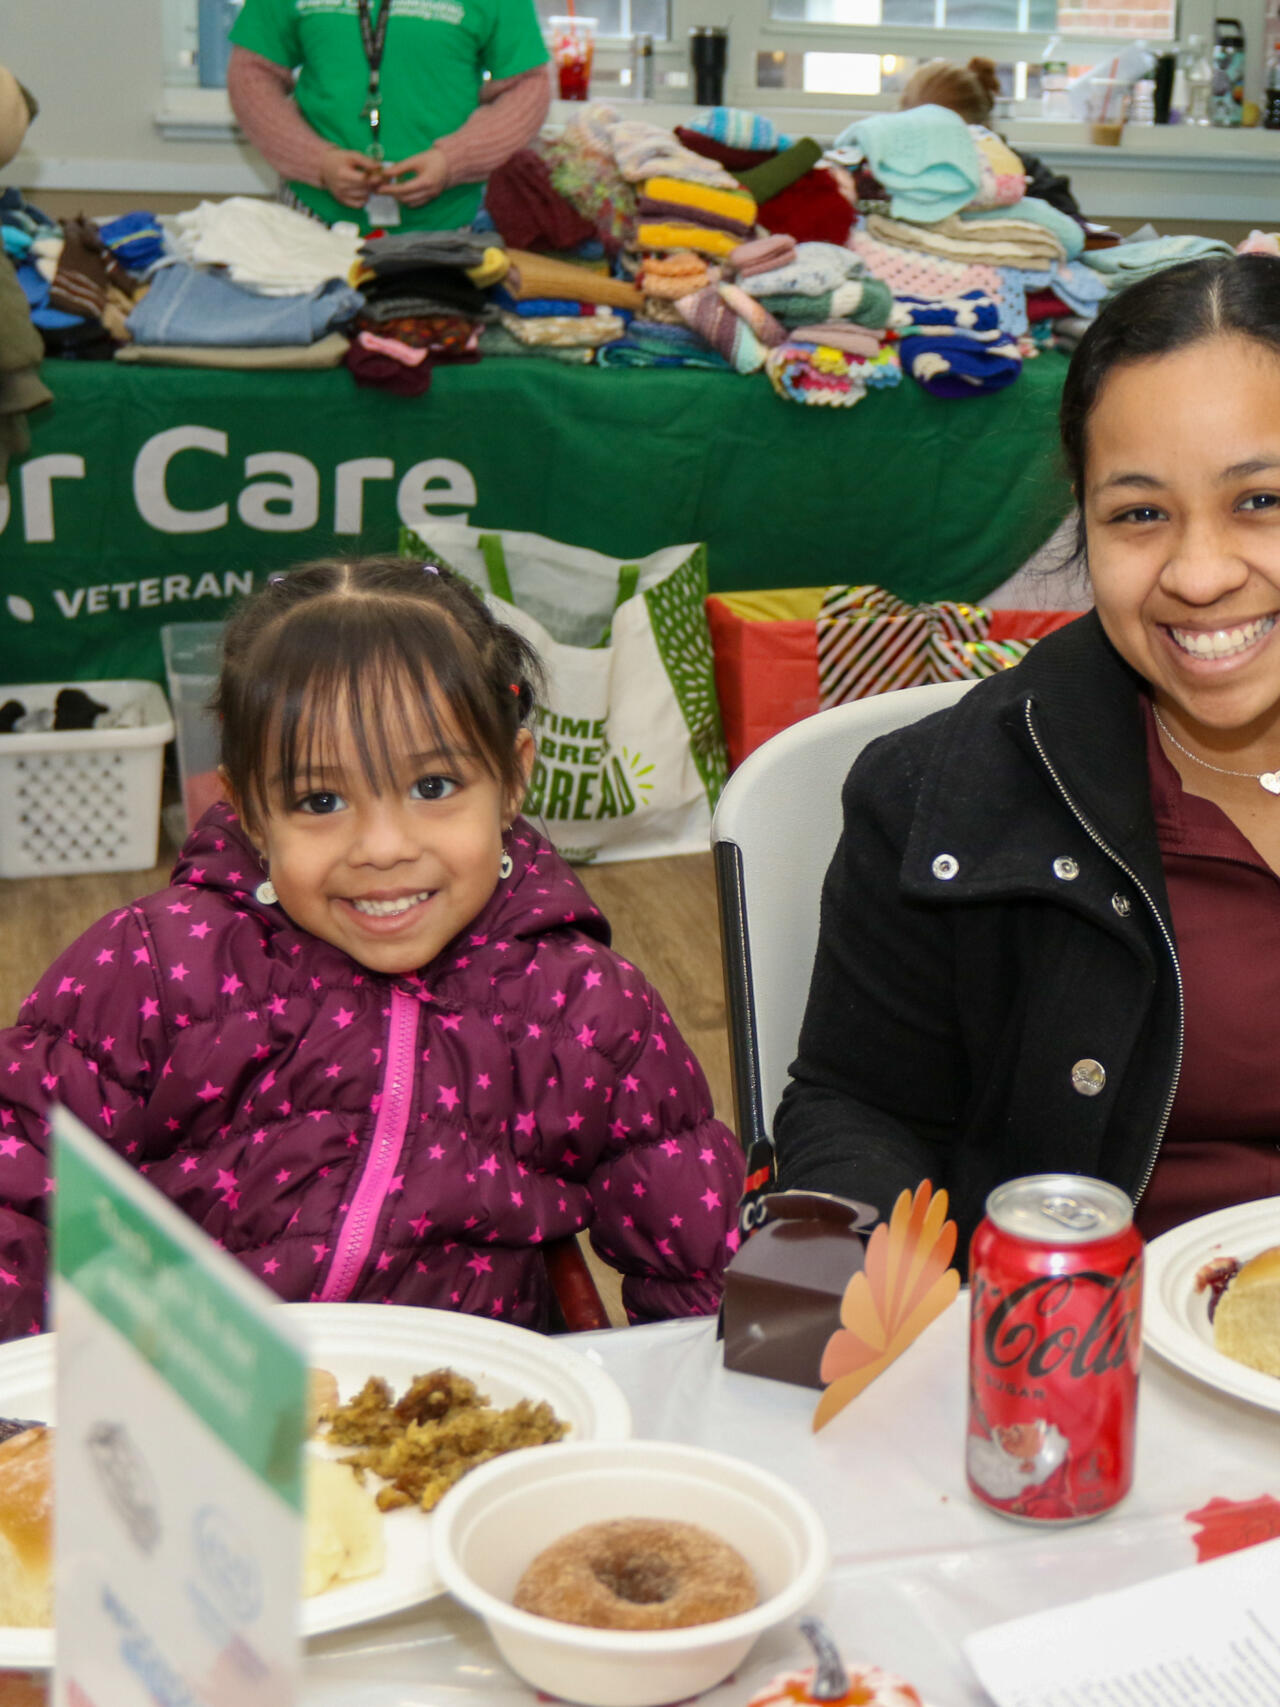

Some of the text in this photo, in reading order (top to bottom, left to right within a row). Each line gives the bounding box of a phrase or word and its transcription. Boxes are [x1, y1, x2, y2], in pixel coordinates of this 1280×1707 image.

[0, 425, 478, 543] r Care
[53, 570, 254, 619] VETERAN
[536, 705, 607, 739] TIME
[541, 736, 611, 766] BRE
[520, 755, 636, 820] BREAD
